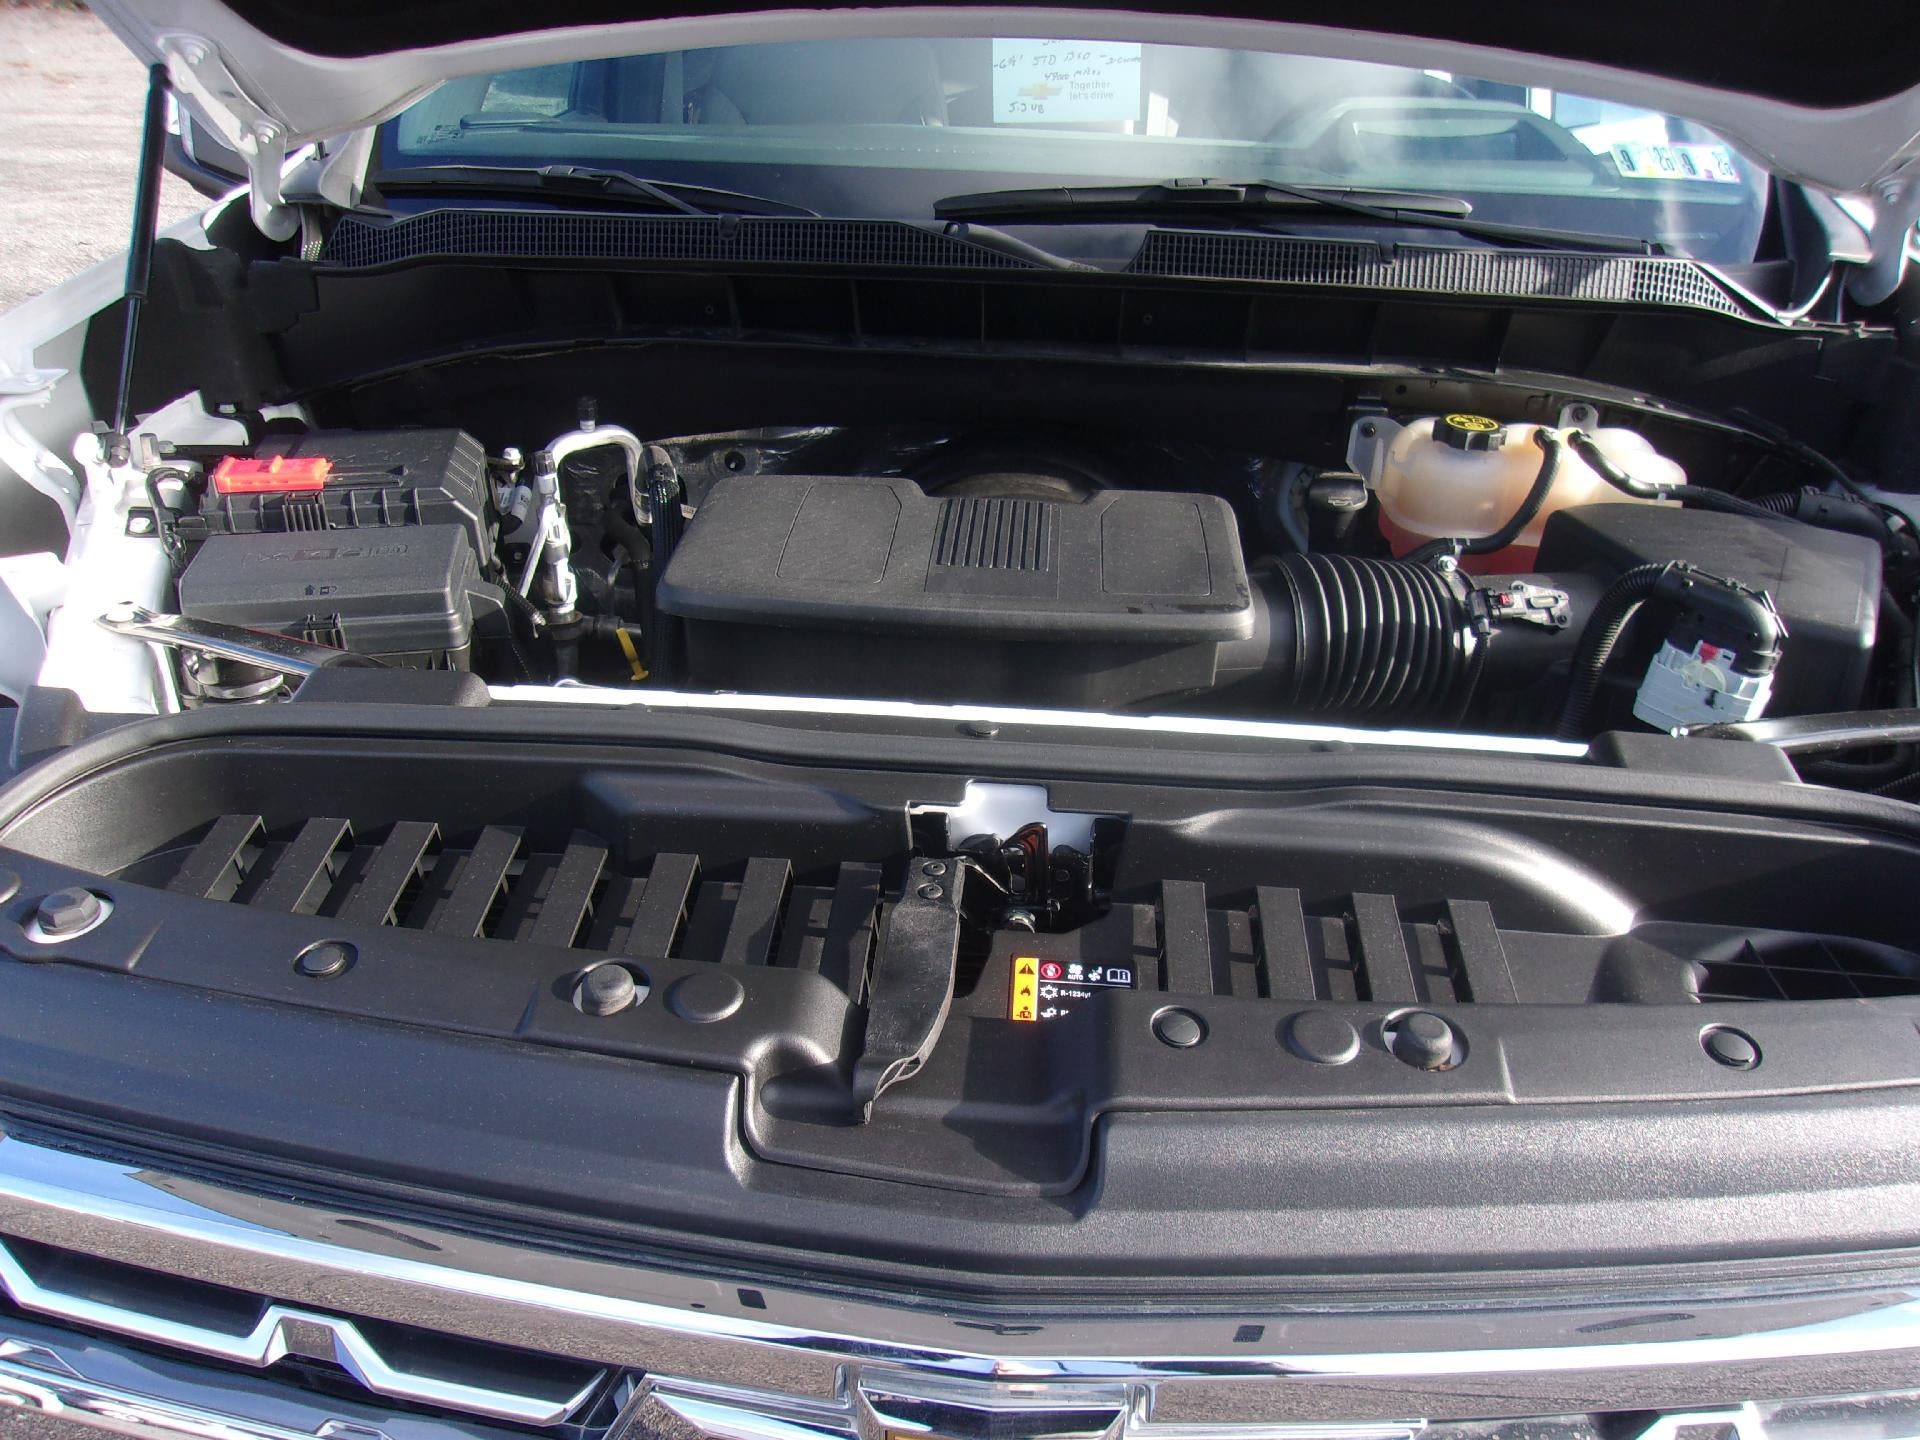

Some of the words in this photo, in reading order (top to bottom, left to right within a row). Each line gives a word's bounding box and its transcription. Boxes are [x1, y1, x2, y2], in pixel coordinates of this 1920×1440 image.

[1069, 80, 1110, 90] Together
[1069, 91, 1089, 100] let's
[1091, 92, 1114, 100] drive
[1060, 990, 1091, 998] R-1234yf
